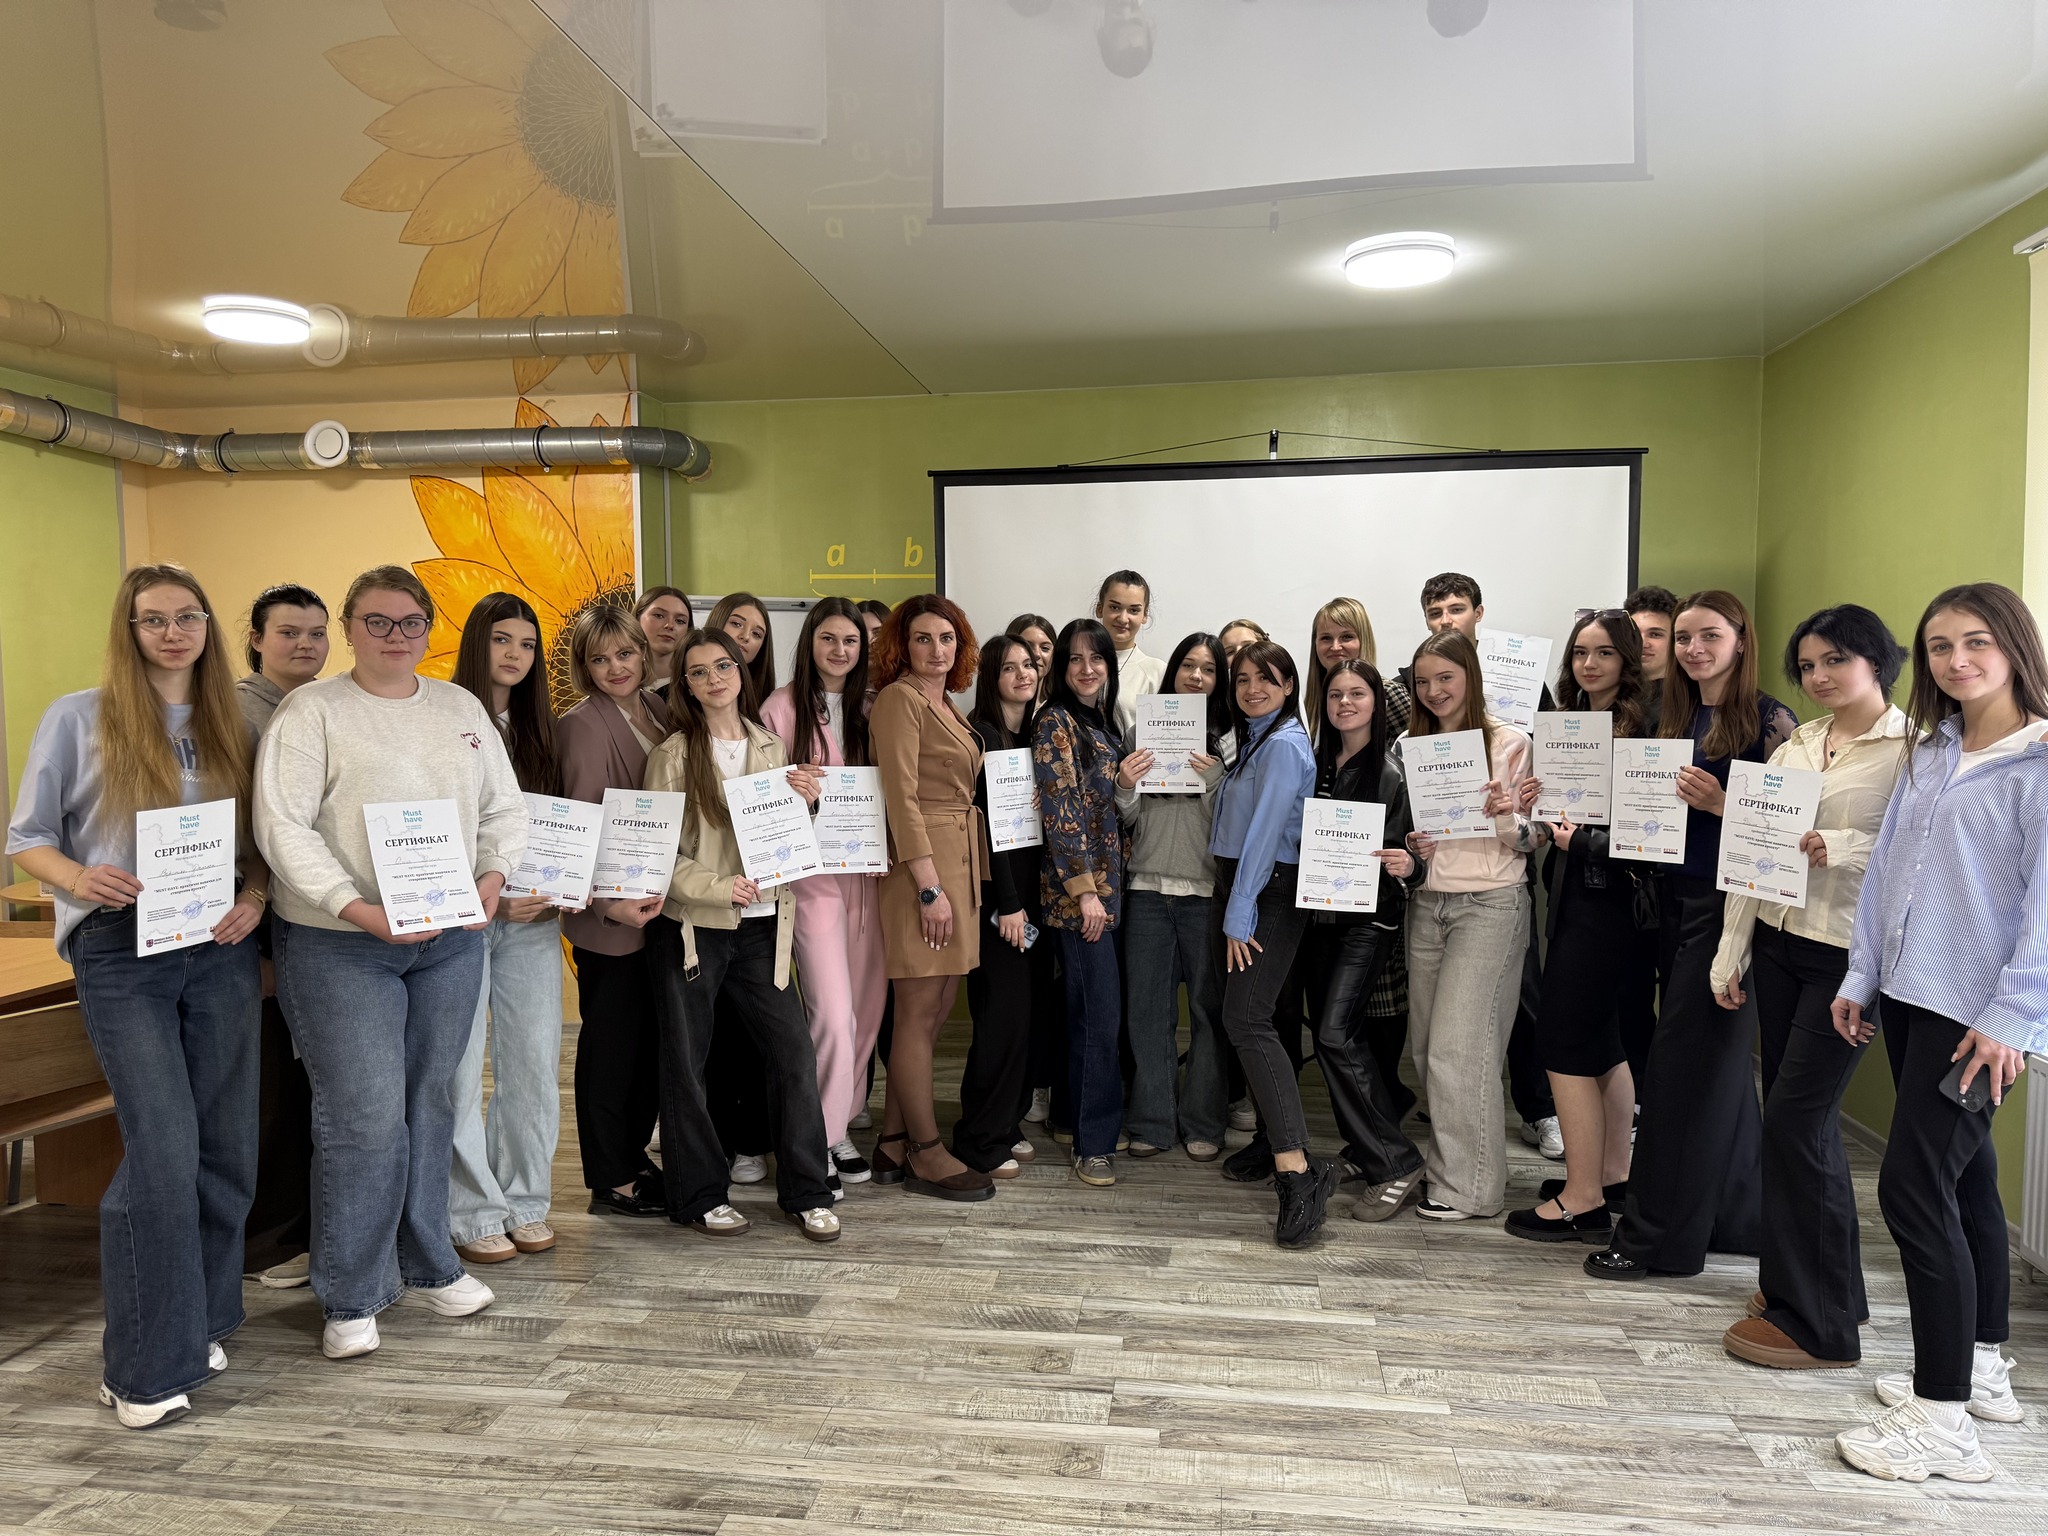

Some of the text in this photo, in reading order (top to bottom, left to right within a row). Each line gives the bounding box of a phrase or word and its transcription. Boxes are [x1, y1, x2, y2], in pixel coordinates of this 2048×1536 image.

[826, 536, 924, 567] a b
[1487, 654, 1536, 668] СЕРТИФІКАТ
[1545, 742, 1600, 750] СЕРТИФІКАТ
[1418, 760, 1474, 773] СЕРТИФІКАТ
[996, 774, 1032, 784] СЕРТИФІКАТ
[1625, 770, 1678, 779] СЕРТИФІКАТ
[1764, 773, 1783, 782] Must
[754, 778, 770, 787] Must
[1763, 780, 1782, 788] have
[636, 802, 652, 810] have
[742, 797, 794, 816] СЕРТИФІКАТ
[1738, 798, 1801, 816] СЕРТИФІКАТ
[402, 809, 422, 817] Must
[179, 814, 200, 823] Must
[612, 818, 670, 829] СЕРТИФІКАТ
[180, 822, 200, 830] have
[1315, 829, 1371, 840] СЕРТИФІКАТ
[385, 834, 449, 848] СЕРТИФІКАТ
[154, 839, 222, 858] СЕРТИФІКАТ
